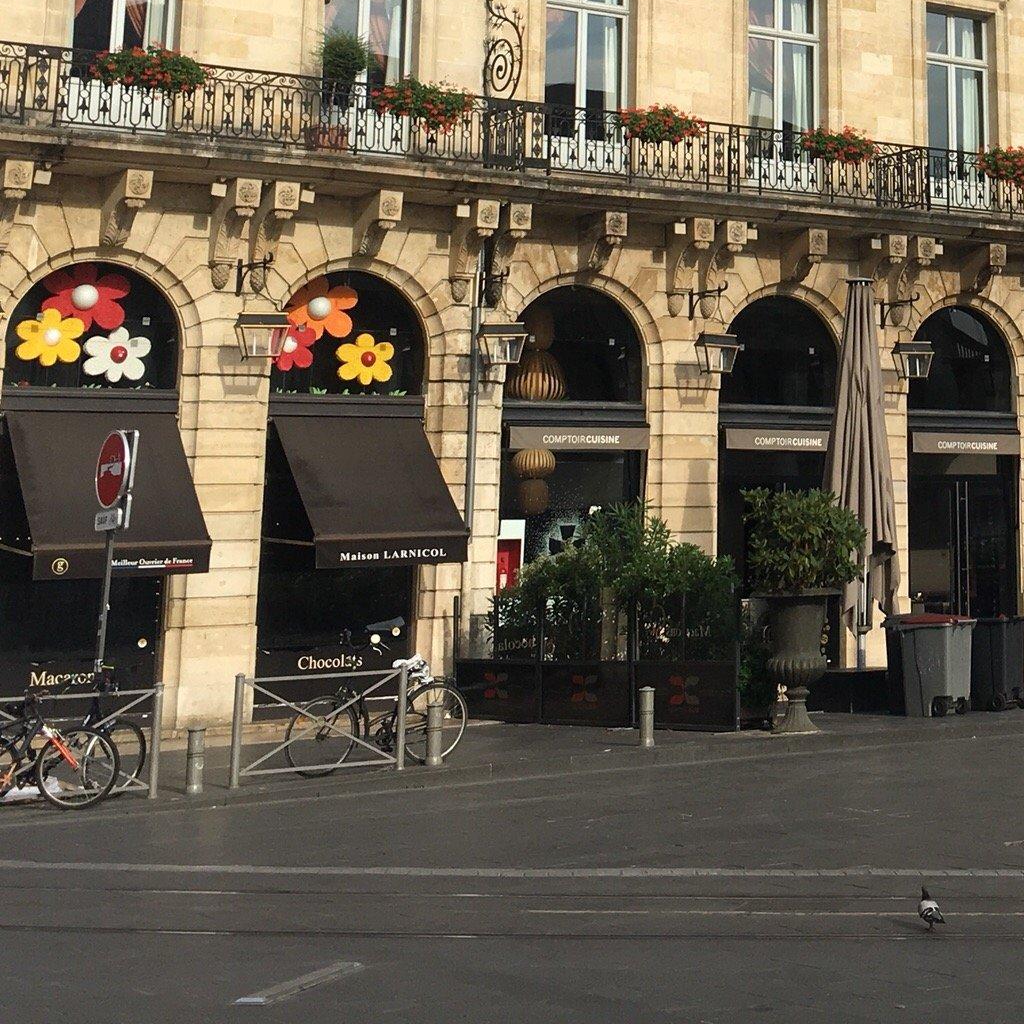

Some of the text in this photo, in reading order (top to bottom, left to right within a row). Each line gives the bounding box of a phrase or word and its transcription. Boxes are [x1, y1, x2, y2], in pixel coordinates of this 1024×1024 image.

[340, 548, 447, 561] Maison LARNICOL
[111, 559, 138, 567] Meilleur
